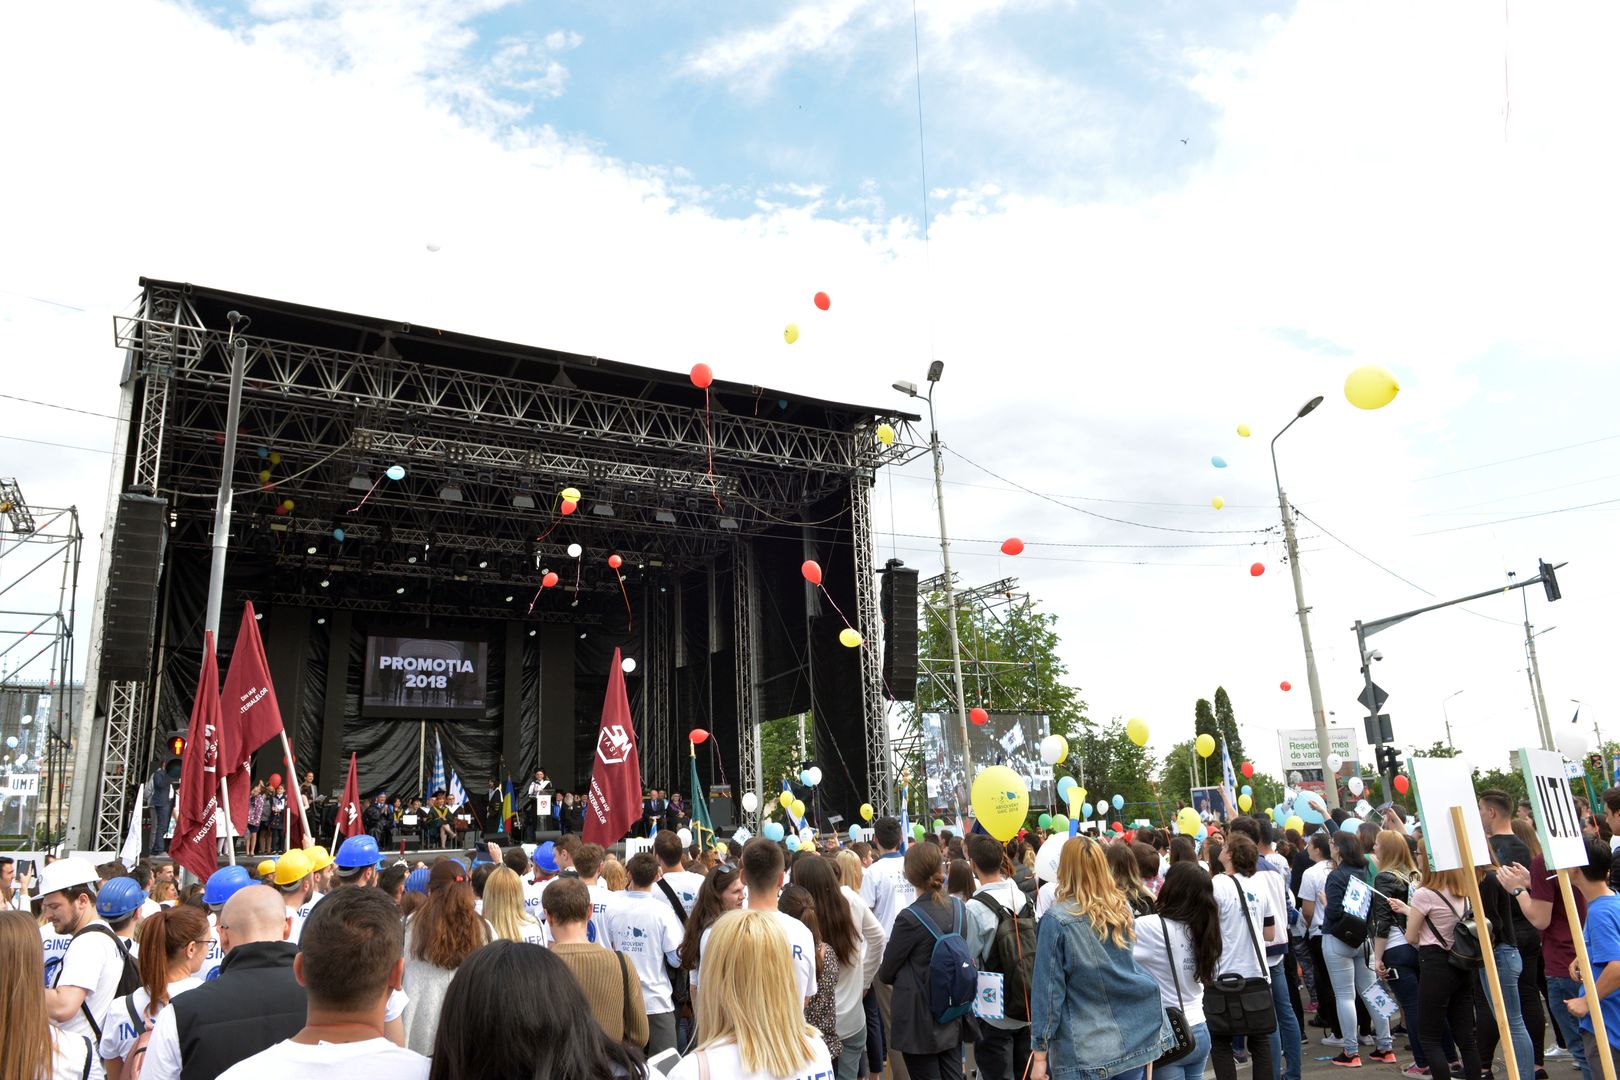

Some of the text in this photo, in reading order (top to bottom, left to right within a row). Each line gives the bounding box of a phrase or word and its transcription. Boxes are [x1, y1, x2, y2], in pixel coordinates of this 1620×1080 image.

[379, 656, 474, 678] PROMOȚIA
[405, 674, 448, 689] 2018
[1331, 741, 1350, 749] mea
[1290, 751, 1301, 760] de
[12, 778, 35, 791] UMF
